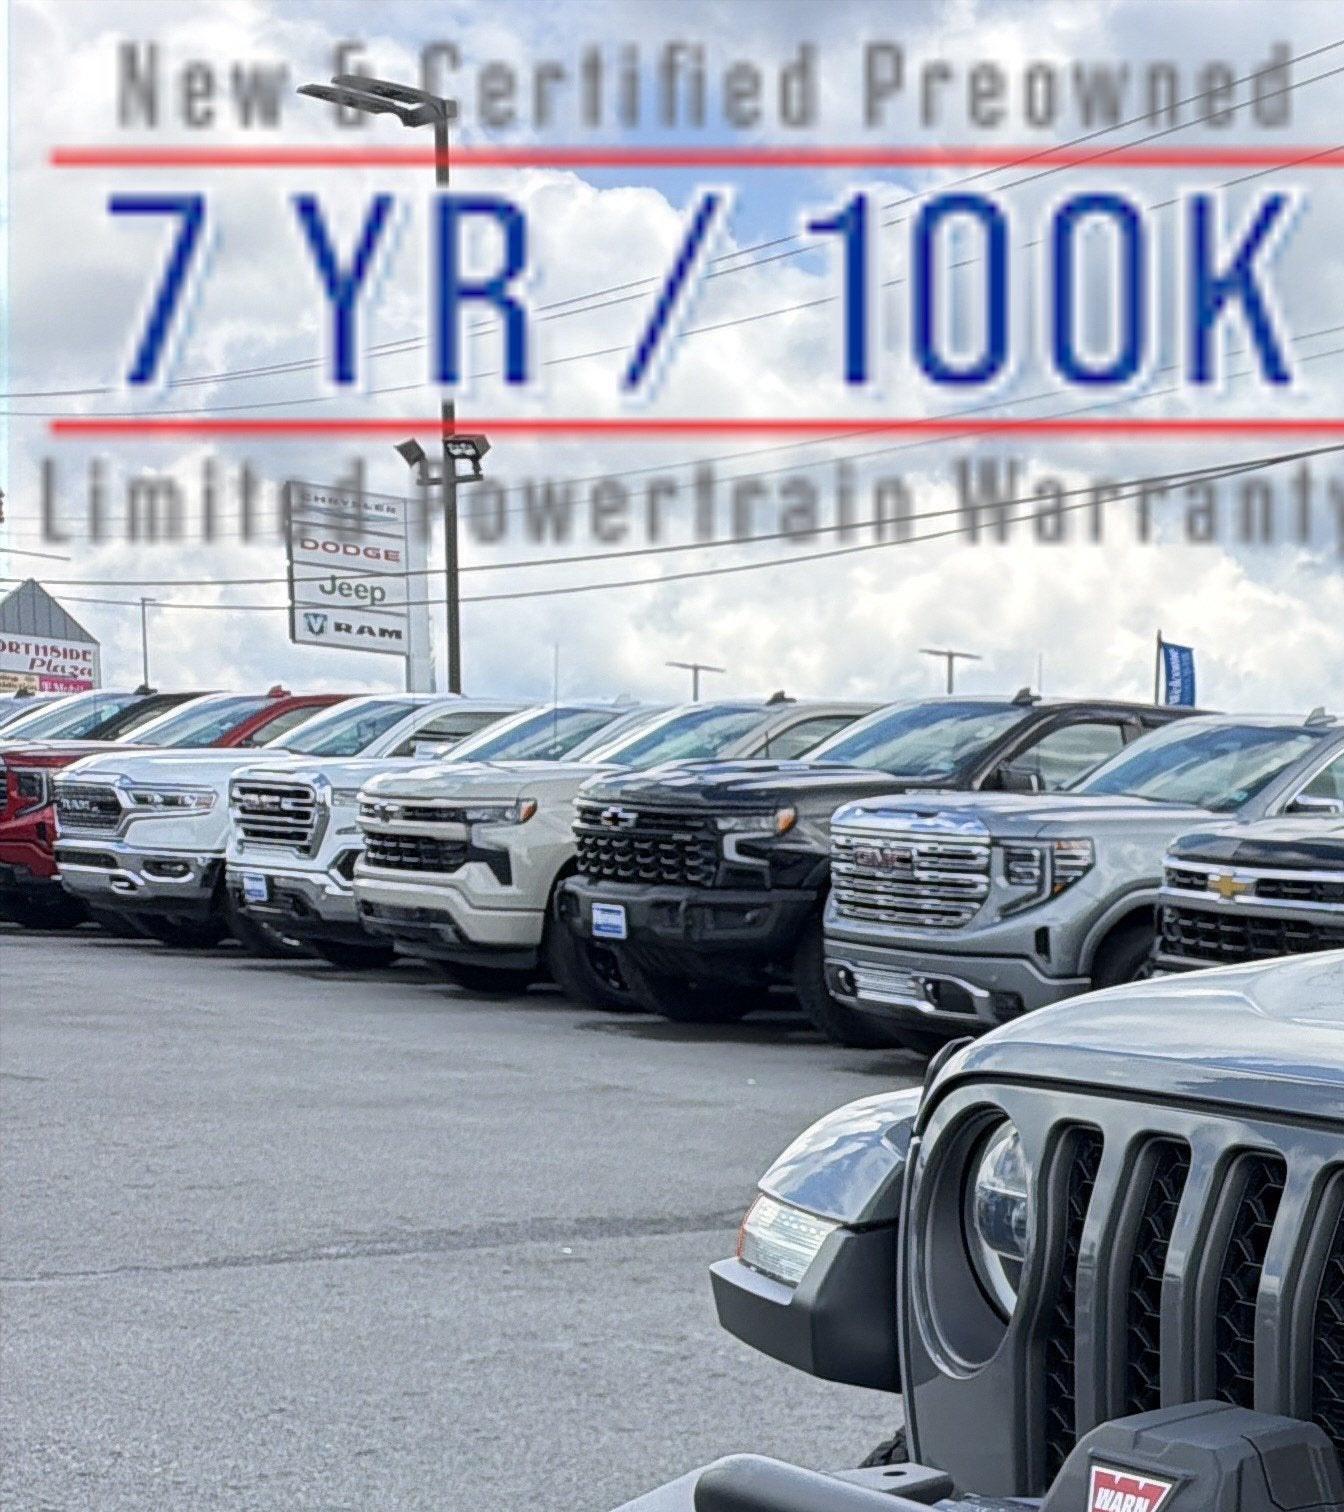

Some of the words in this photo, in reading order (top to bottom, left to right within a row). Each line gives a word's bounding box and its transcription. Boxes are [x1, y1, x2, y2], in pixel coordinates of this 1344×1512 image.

[300, 538, 401, 562] DODGE
[319, 575, 386, 606] Jeep
[333, 621, 403, 640] RAM
[29, 657, 93, 678] Plaza
